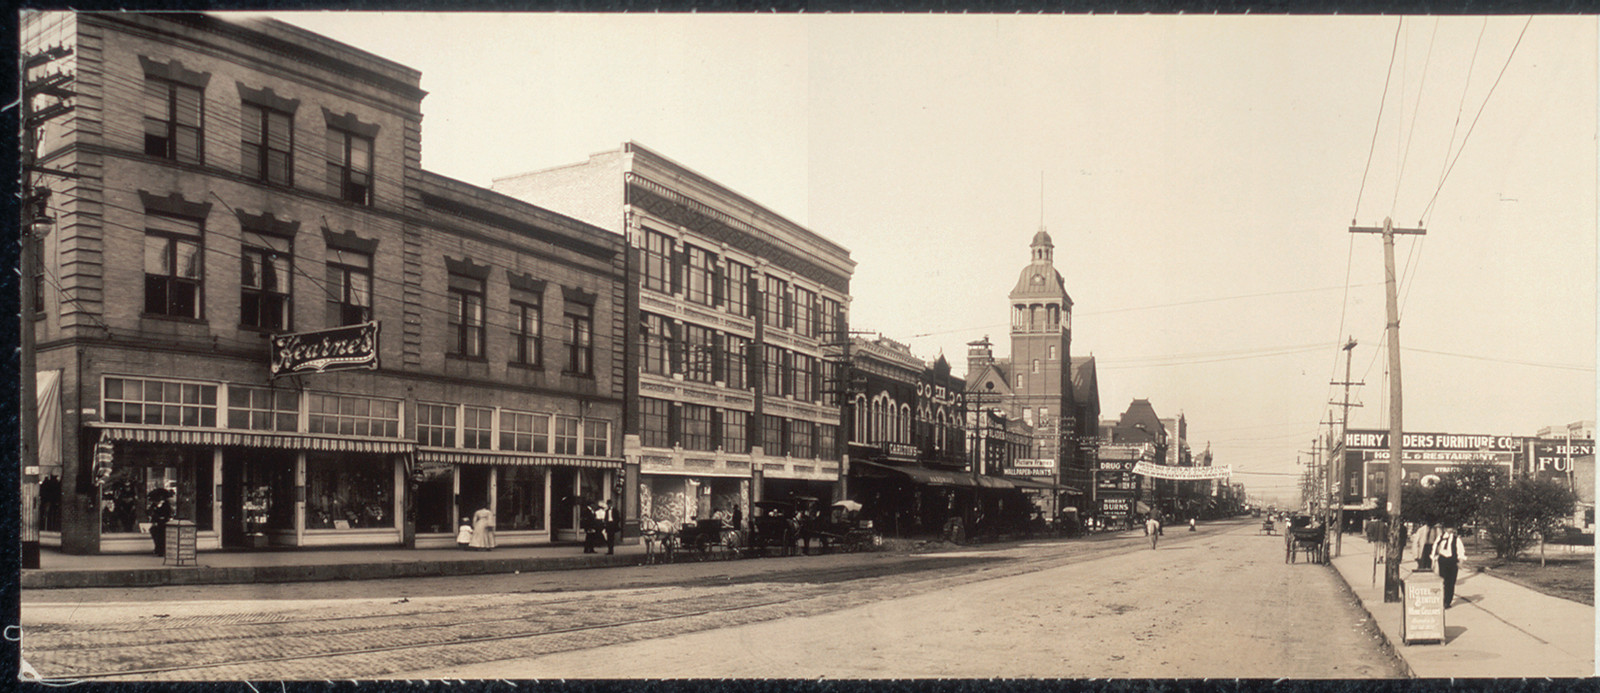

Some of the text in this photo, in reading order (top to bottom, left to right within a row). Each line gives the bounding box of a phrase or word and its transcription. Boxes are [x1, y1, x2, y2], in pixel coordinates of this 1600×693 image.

[271, 327, 373, 374] Hearne's
[1345, 433, 1384, 447] HENRY
[1436, 435, 1495, 449] FURNITURE
[1100, 462, 1121, 470] DRUG
[1103, 503, 1129, 511] BURNS
